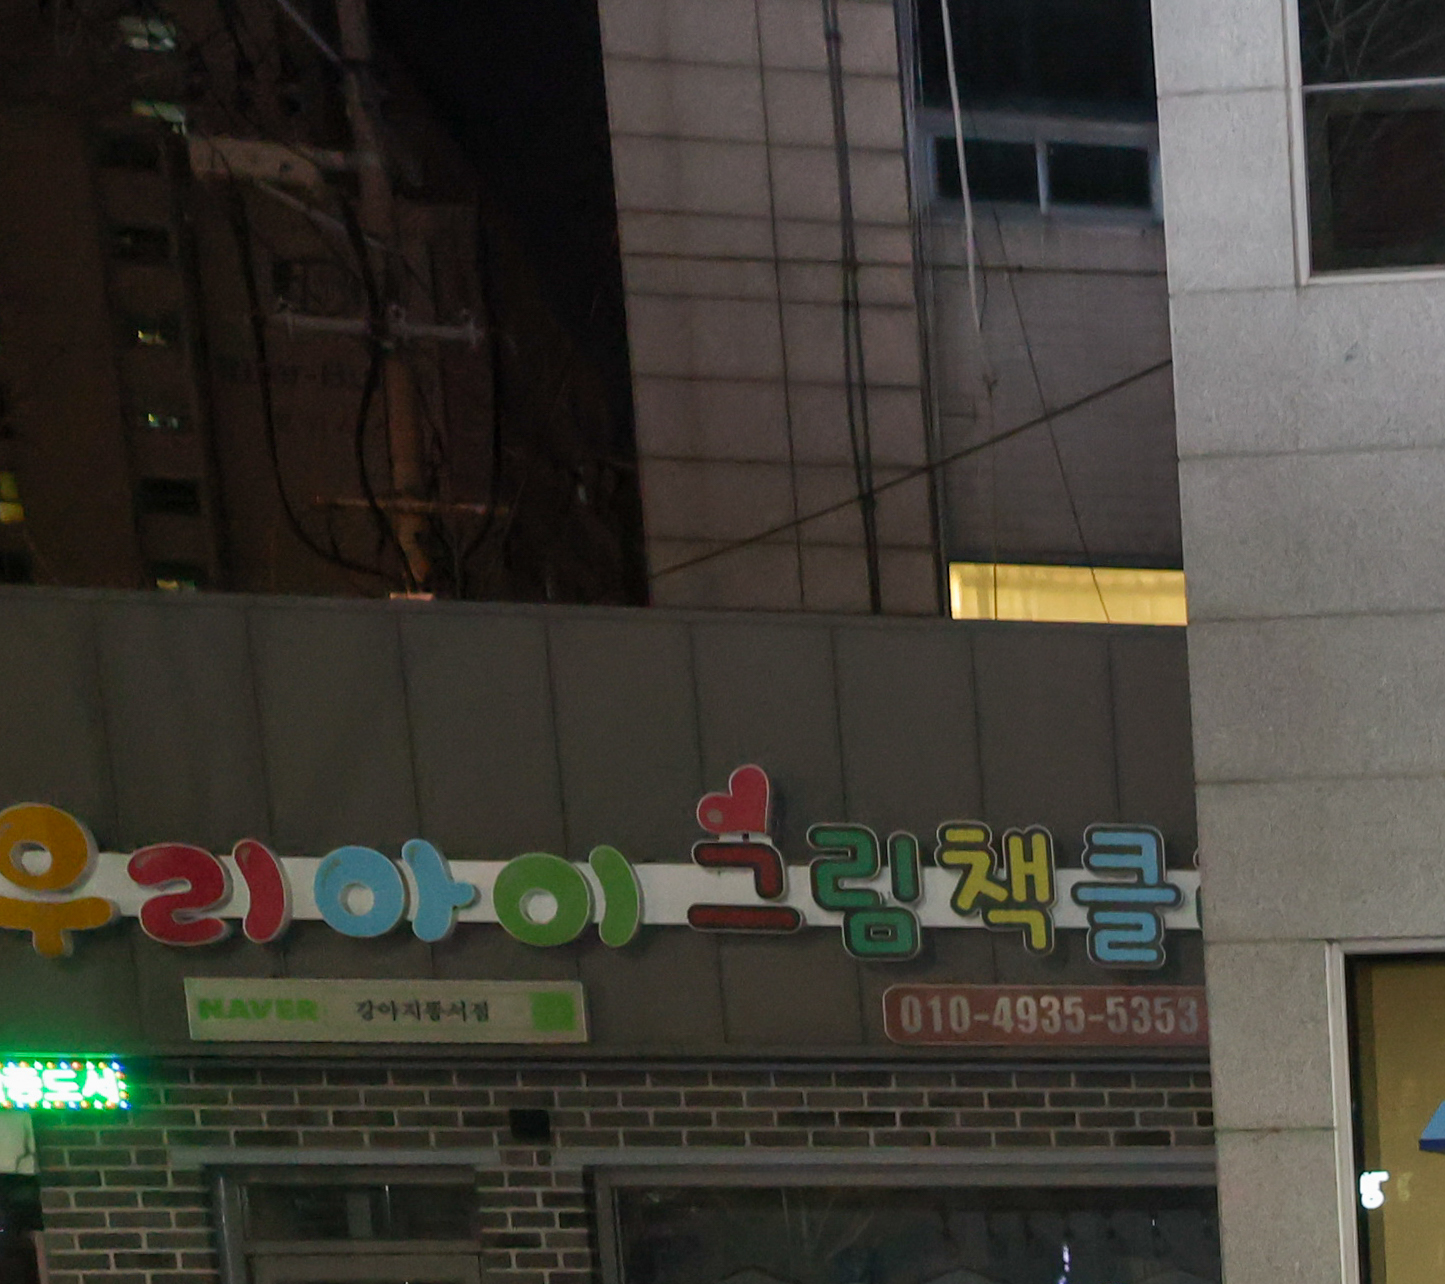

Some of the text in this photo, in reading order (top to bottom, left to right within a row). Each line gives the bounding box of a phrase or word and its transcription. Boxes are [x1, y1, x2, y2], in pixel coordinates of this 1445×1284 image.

[0, 801, 1201, 968] 우리아이 그림책클
[901, 995, 1198, 1034] 010-4935-5353
